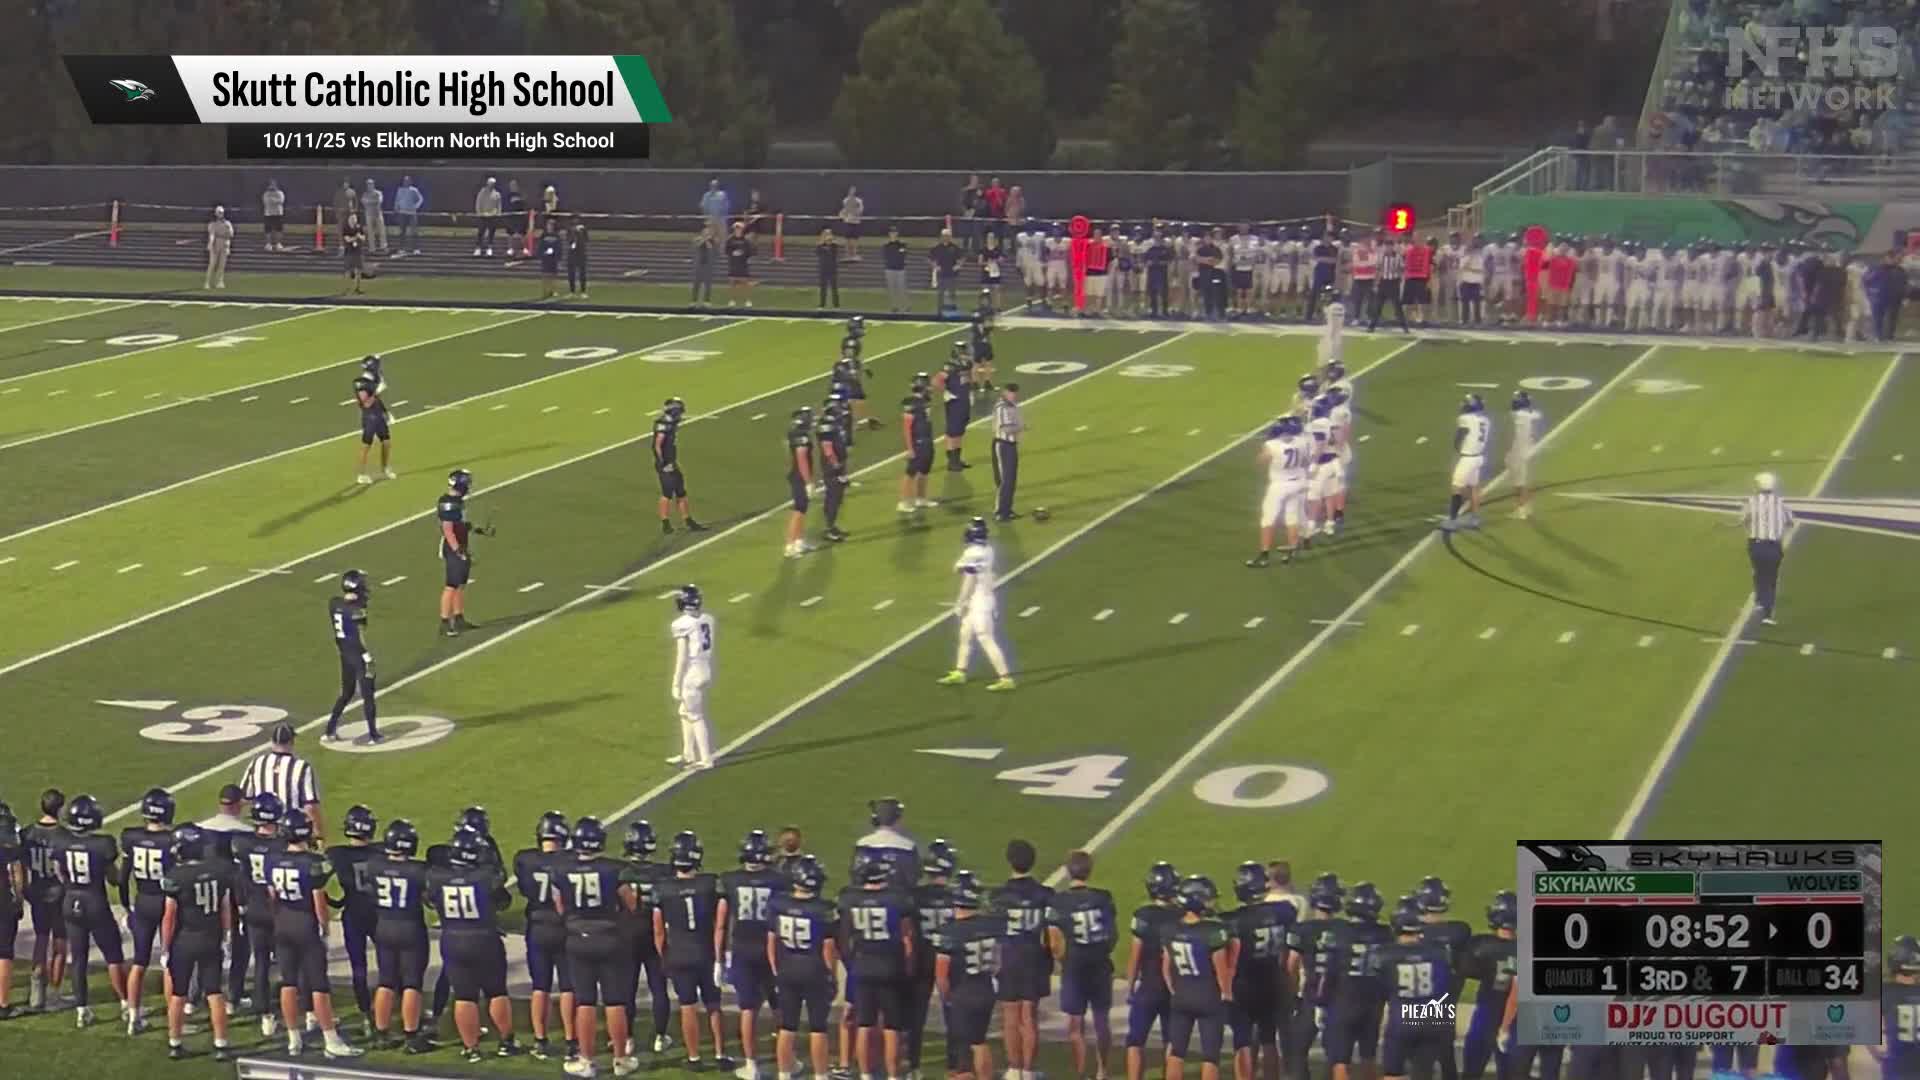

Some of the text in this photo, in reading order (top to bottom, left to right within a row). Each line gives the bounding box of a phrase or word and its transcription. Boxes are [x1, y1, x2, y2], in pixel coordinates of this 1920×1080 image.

[66, 851, 91, 885] 19
[194, 880, 219, 914] 41
[376, 876, 408, 908] 37
[442, 886, 480, 919] 60
[568, 872, 601, 907] 79
[684, 896, 696, 930] 1
[851, 907, 890, 941] 43
[779, 915, 812, 949] 92
[1397, 962, 1434, 998] 98
